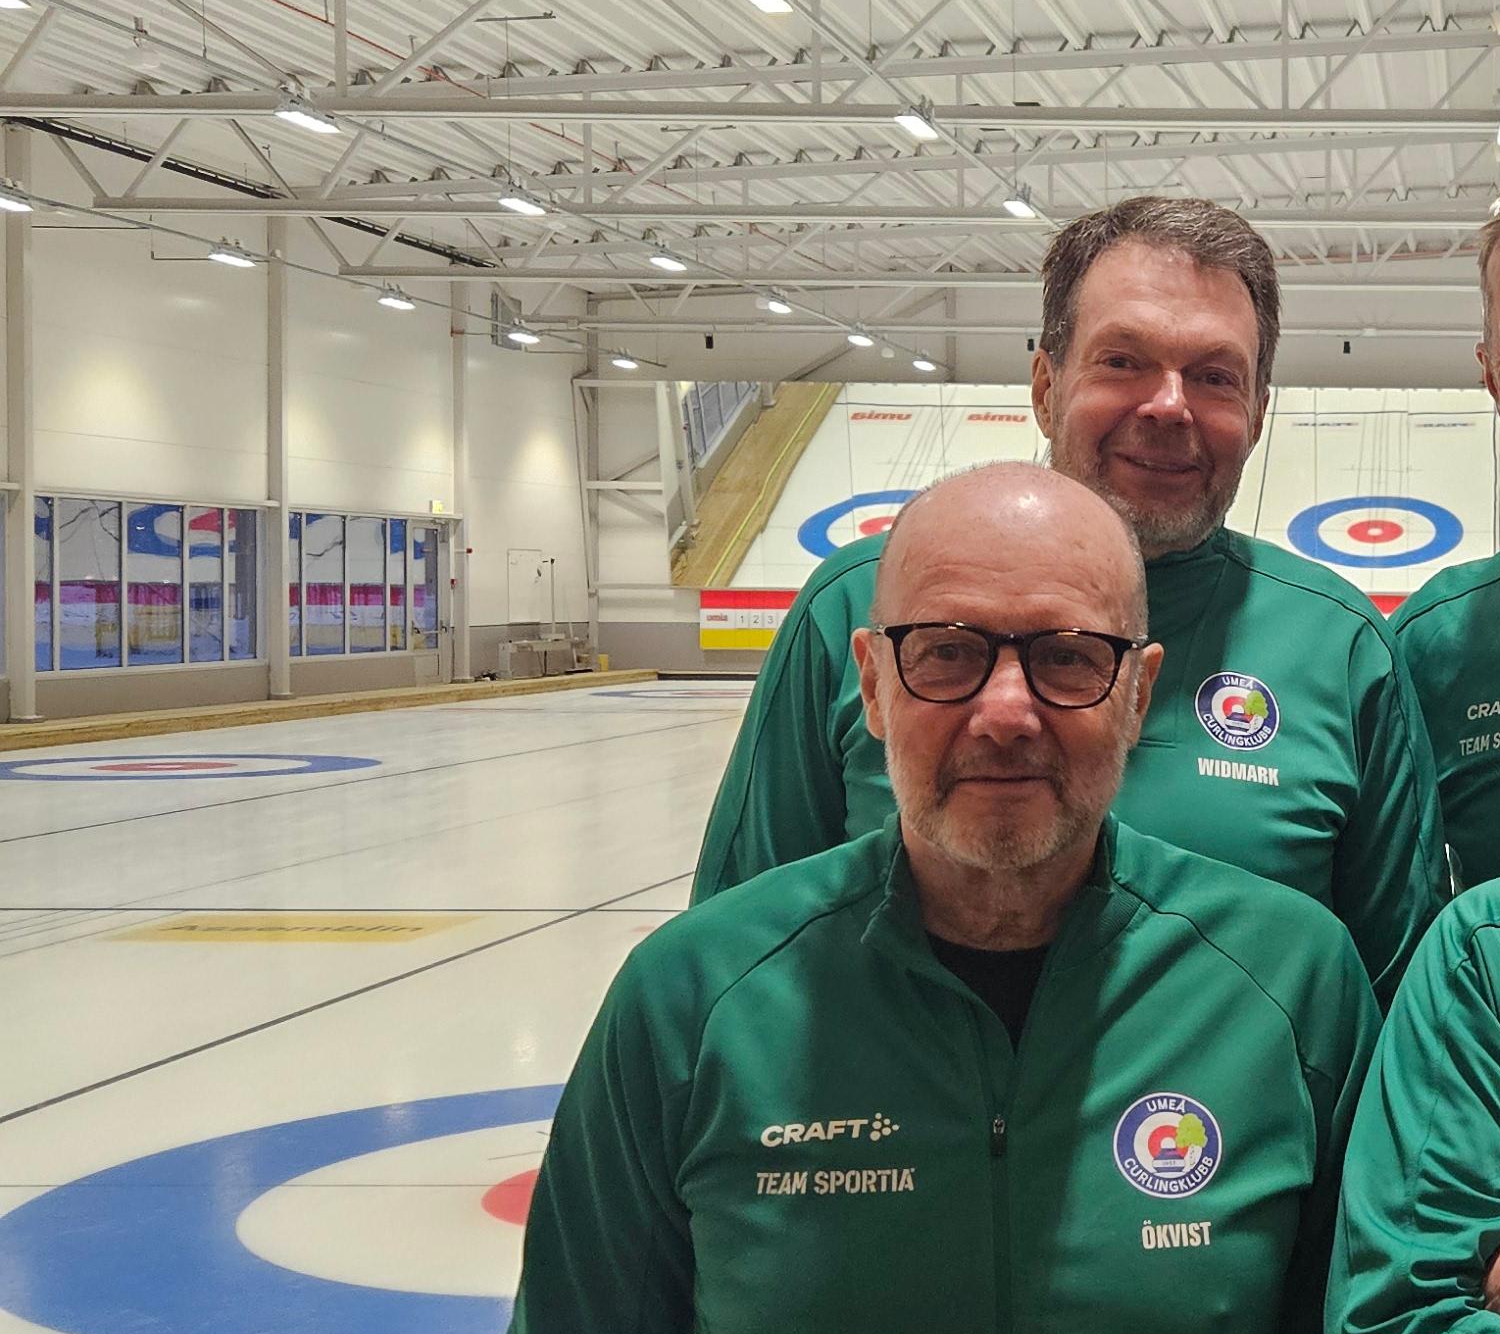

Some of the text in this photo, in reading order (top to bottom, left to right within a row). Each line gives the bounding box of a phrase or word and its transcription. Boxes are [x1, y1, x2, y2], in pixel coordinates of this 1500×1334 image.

[1222, 675, 1255, 689] UMEÅ
[1203, 713, 1272, 747] CURLINGKLUBB
[1459, 734, 1490, 756] TEAM
[1197, 757, 1280, 786] WIDMARK
[1146, 1097, 1187, 1113] UMEÅ
[760, 1119, 869, 1148] CRAFT
[756, 1168, 915, 1195] TEAM SPORTIA
[1124, 1155, 1214, 1193] CURLINGKLUBB
[1141, 1219, 1212, 1250] ÖKVIST
